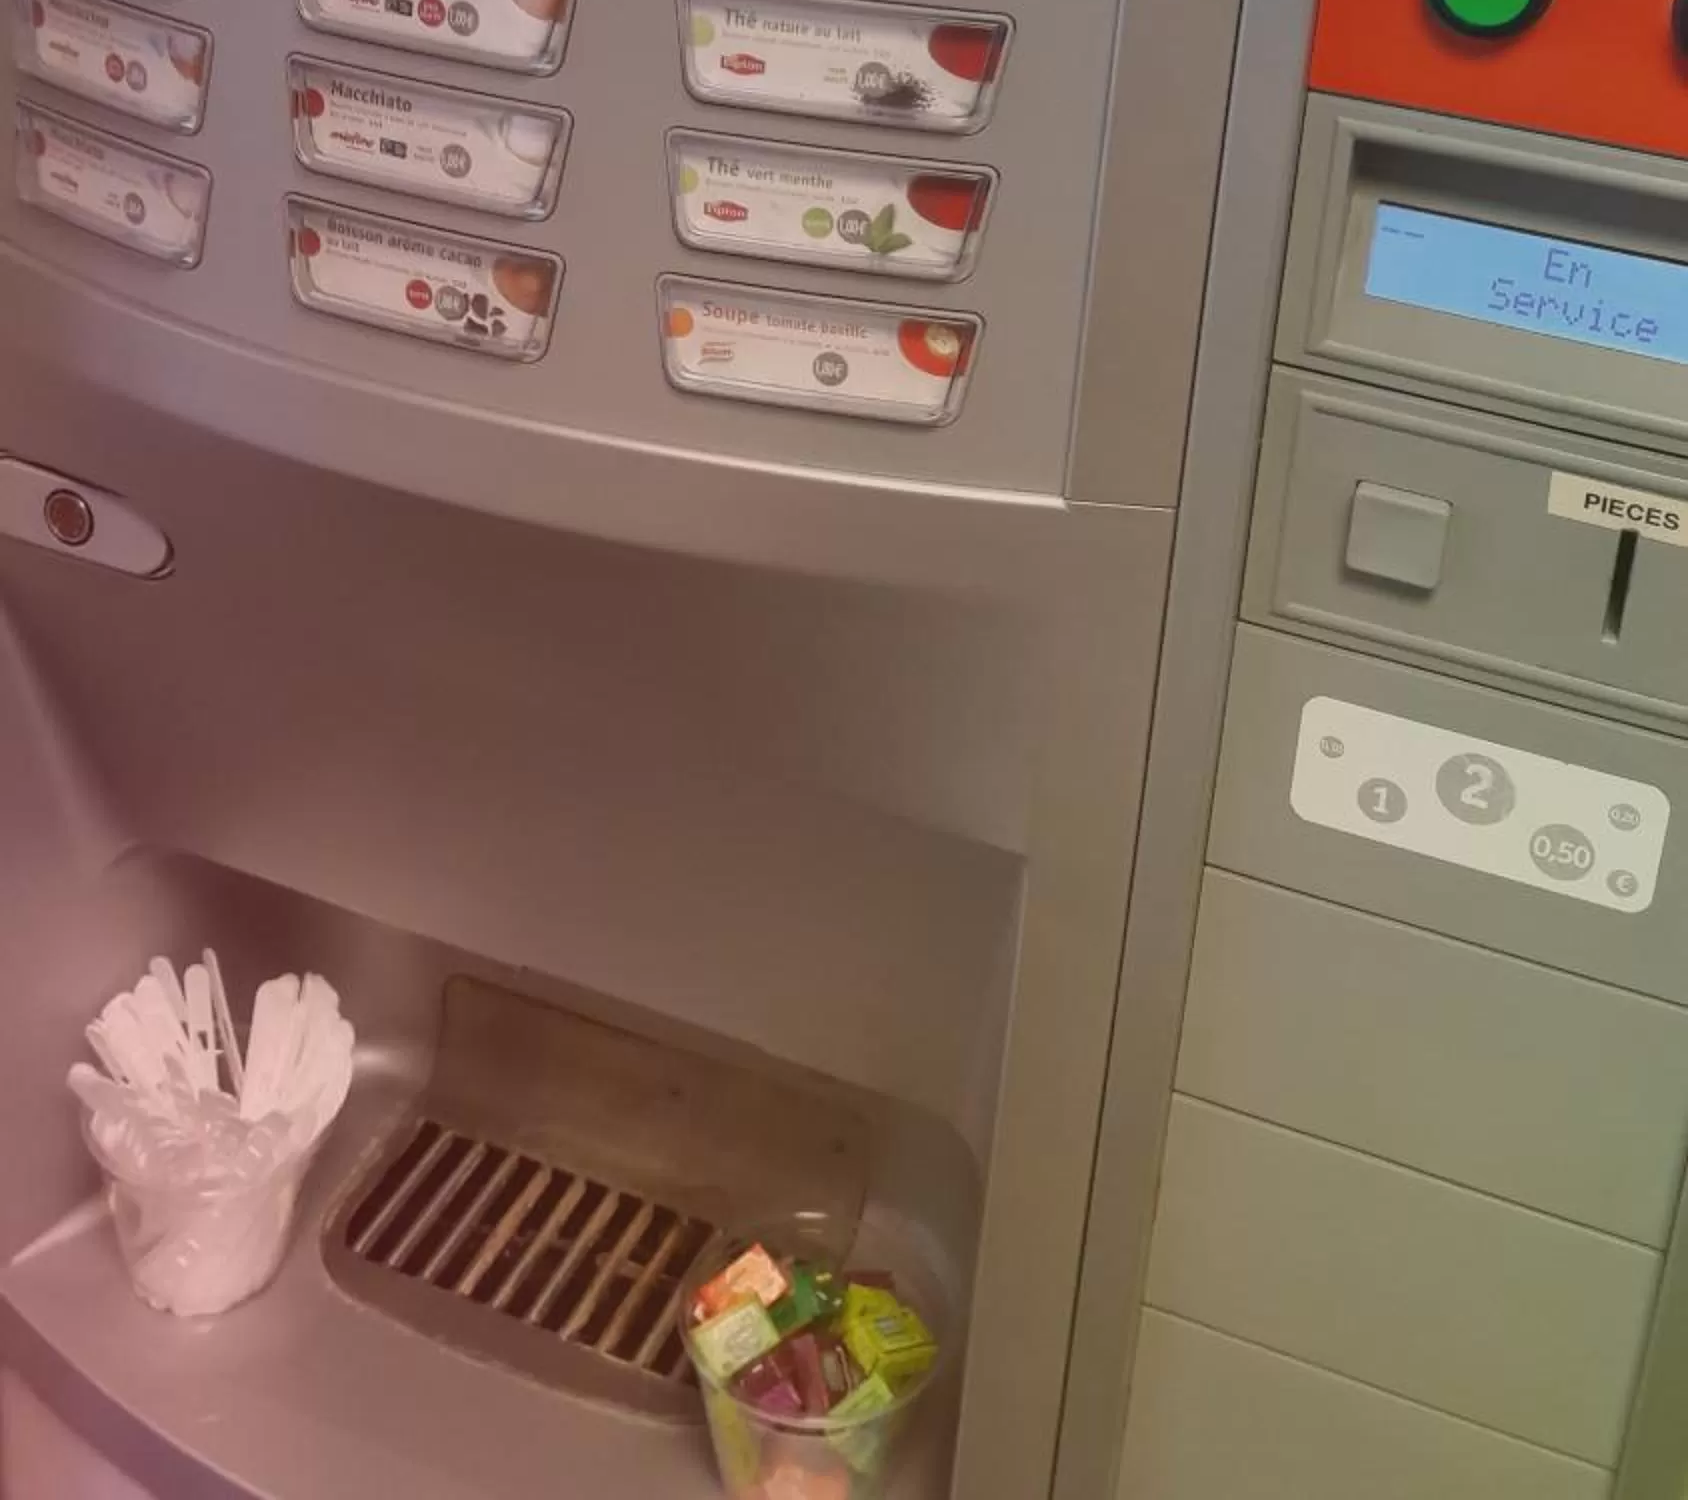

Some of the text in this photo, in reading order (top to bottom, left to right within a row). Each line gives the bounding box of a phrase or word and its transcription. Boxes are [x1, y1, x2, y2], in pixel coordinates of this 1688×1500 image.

[724, 6, 757, 29] Thé
[761, 18, 809, 37] nature
[836, 22, 862, 44] lait
[330, 80, 413, 114] Macchiato
[707, 155, 740, 177] Thé
[745, 166, 775, 183] vert
[778, 172, 833, 191] menthe
[326, 214, 384, 246] Boisson
[437, 246, 483, 269] cacao
[1543, 247, 1593, 289] En
[701, 300, 761, 328] Soupe
[764, 314, 817, 334] tomate
[819, 321, 870, 341] basilic
[1487, 277, 1659, 343] Service
[1583, 492, 1681, 532] PIECES
[1371, 785, 1390, 815] 1
[1459, 763, 1494, 809] 2
[1532, 835, 1592, 870] 0,50
